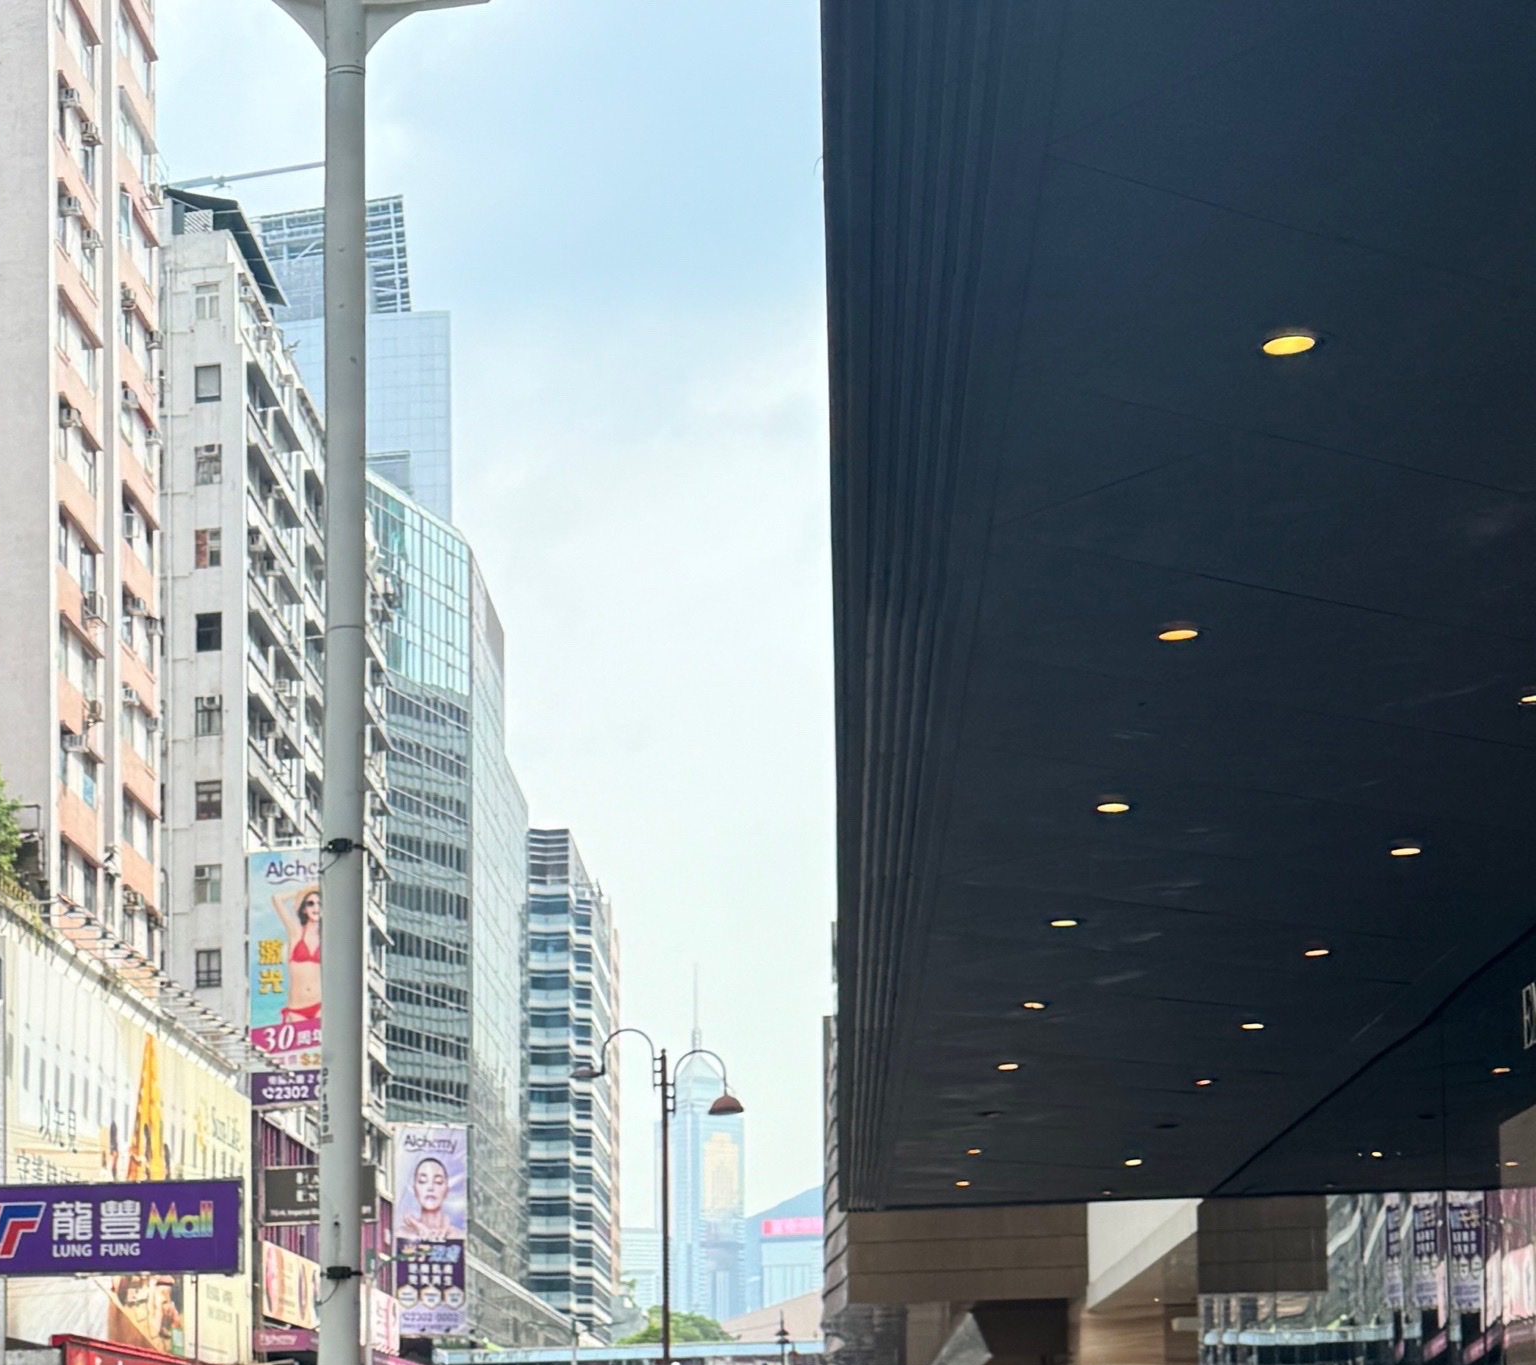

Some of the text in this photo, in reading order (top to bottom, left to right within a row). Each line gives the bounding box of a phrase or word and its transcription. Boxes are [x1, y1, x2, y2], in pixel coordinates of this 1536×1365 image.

[263, 1024, 295, 1052] 30
[52, 1200, 214, 1241] 龍豐 Mall
[52, 1243, 141, 1258] LUNG FUNG
